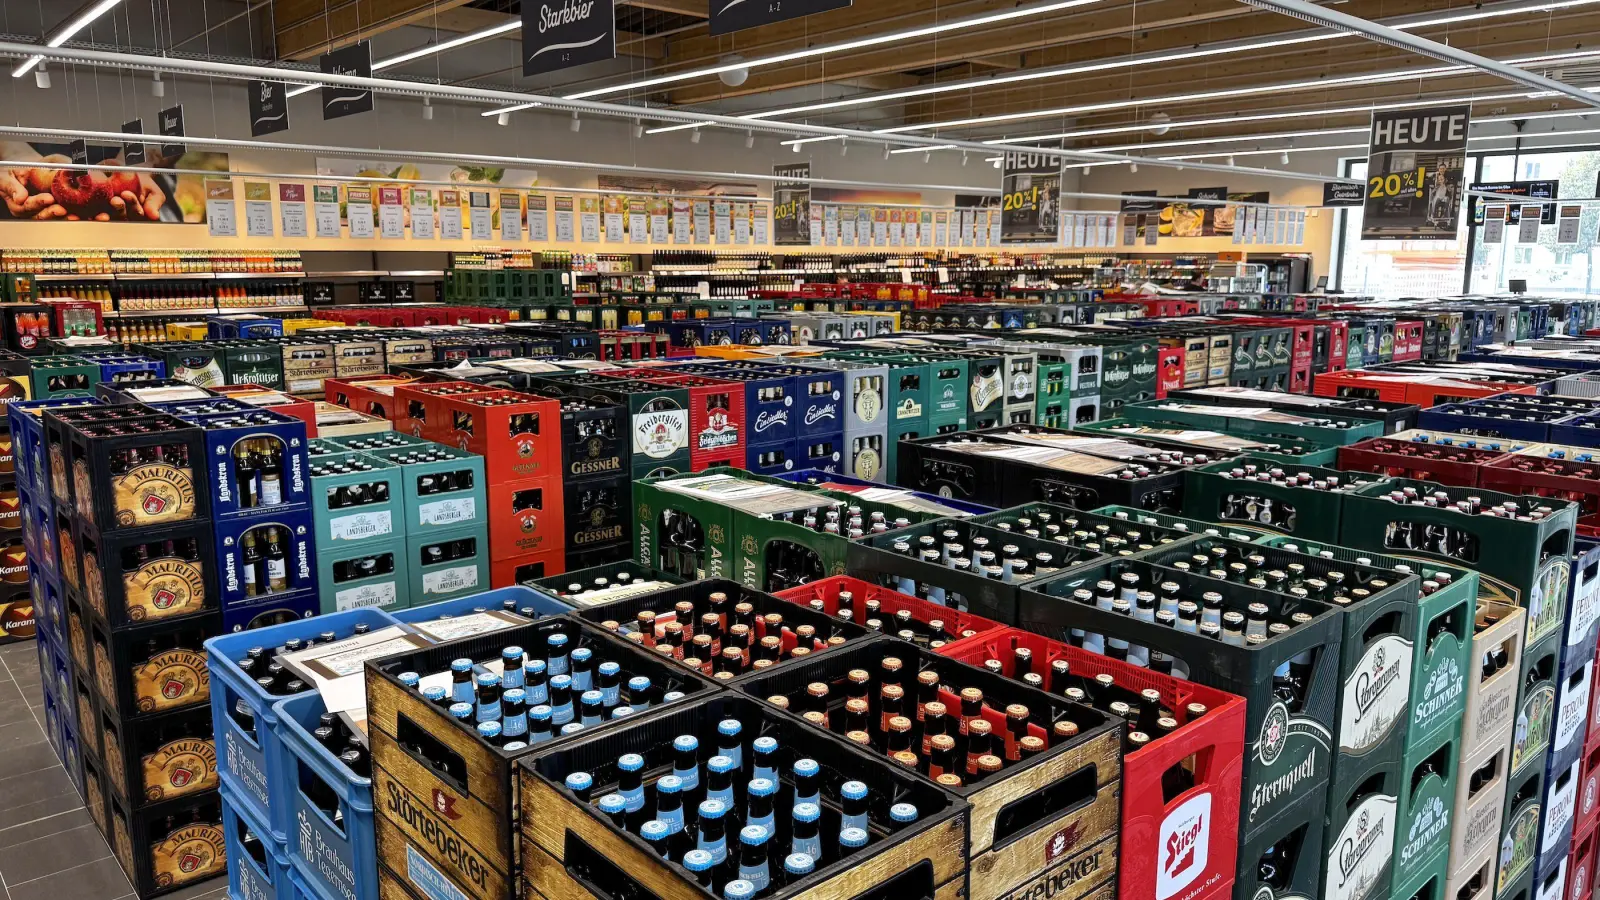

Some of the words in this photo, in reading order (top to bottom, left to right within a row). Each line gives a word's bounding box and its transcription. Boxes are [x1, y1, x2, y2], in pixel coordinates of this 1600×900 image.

[538, 0, 595, 33] Starkbier
[260, 81, 273, 102] Bier
[1373, 114, 1466, 146] HEUTE
[1005, 149, 1060, 170] HEUTE
[774, 168, 809, 186] HEUTE
[0, 396, 21, 404] malz
[571, 456, 621, 474] GESSNER
[134, 467, 195, 504] MAURITIUS
[346, 524, 376, 536] LANDSBERGER
[433, 510, 461, 522] LANDSBERGER
[574, 525, 622, 544] GESSNER
[0, 564, 28, 574] Karam
[144, 562, 204, 597] MAURITIUS
[437, 579, 464, 591] LANDSBERGER
[351, 597, 381, 609] LANDSBERGER
[1574, 588, 1600, 618] PERONI
[5, 618, 35, 629] Karam
[1414, 675, 1463, 724] SCHINNER
[1560, 690, 1586, 724] PERONI
[1249, 746, 1316, 823] Sternquell
[1547, 788, 1573, 826] PERONI
[387, 780, 489, 893] Störtebeker
[1164, 813, 1203, 874] Stiegl
[1400, 809, 1449, 867] SCHINNER
[315, 829, 355, 886] Brauhaus
